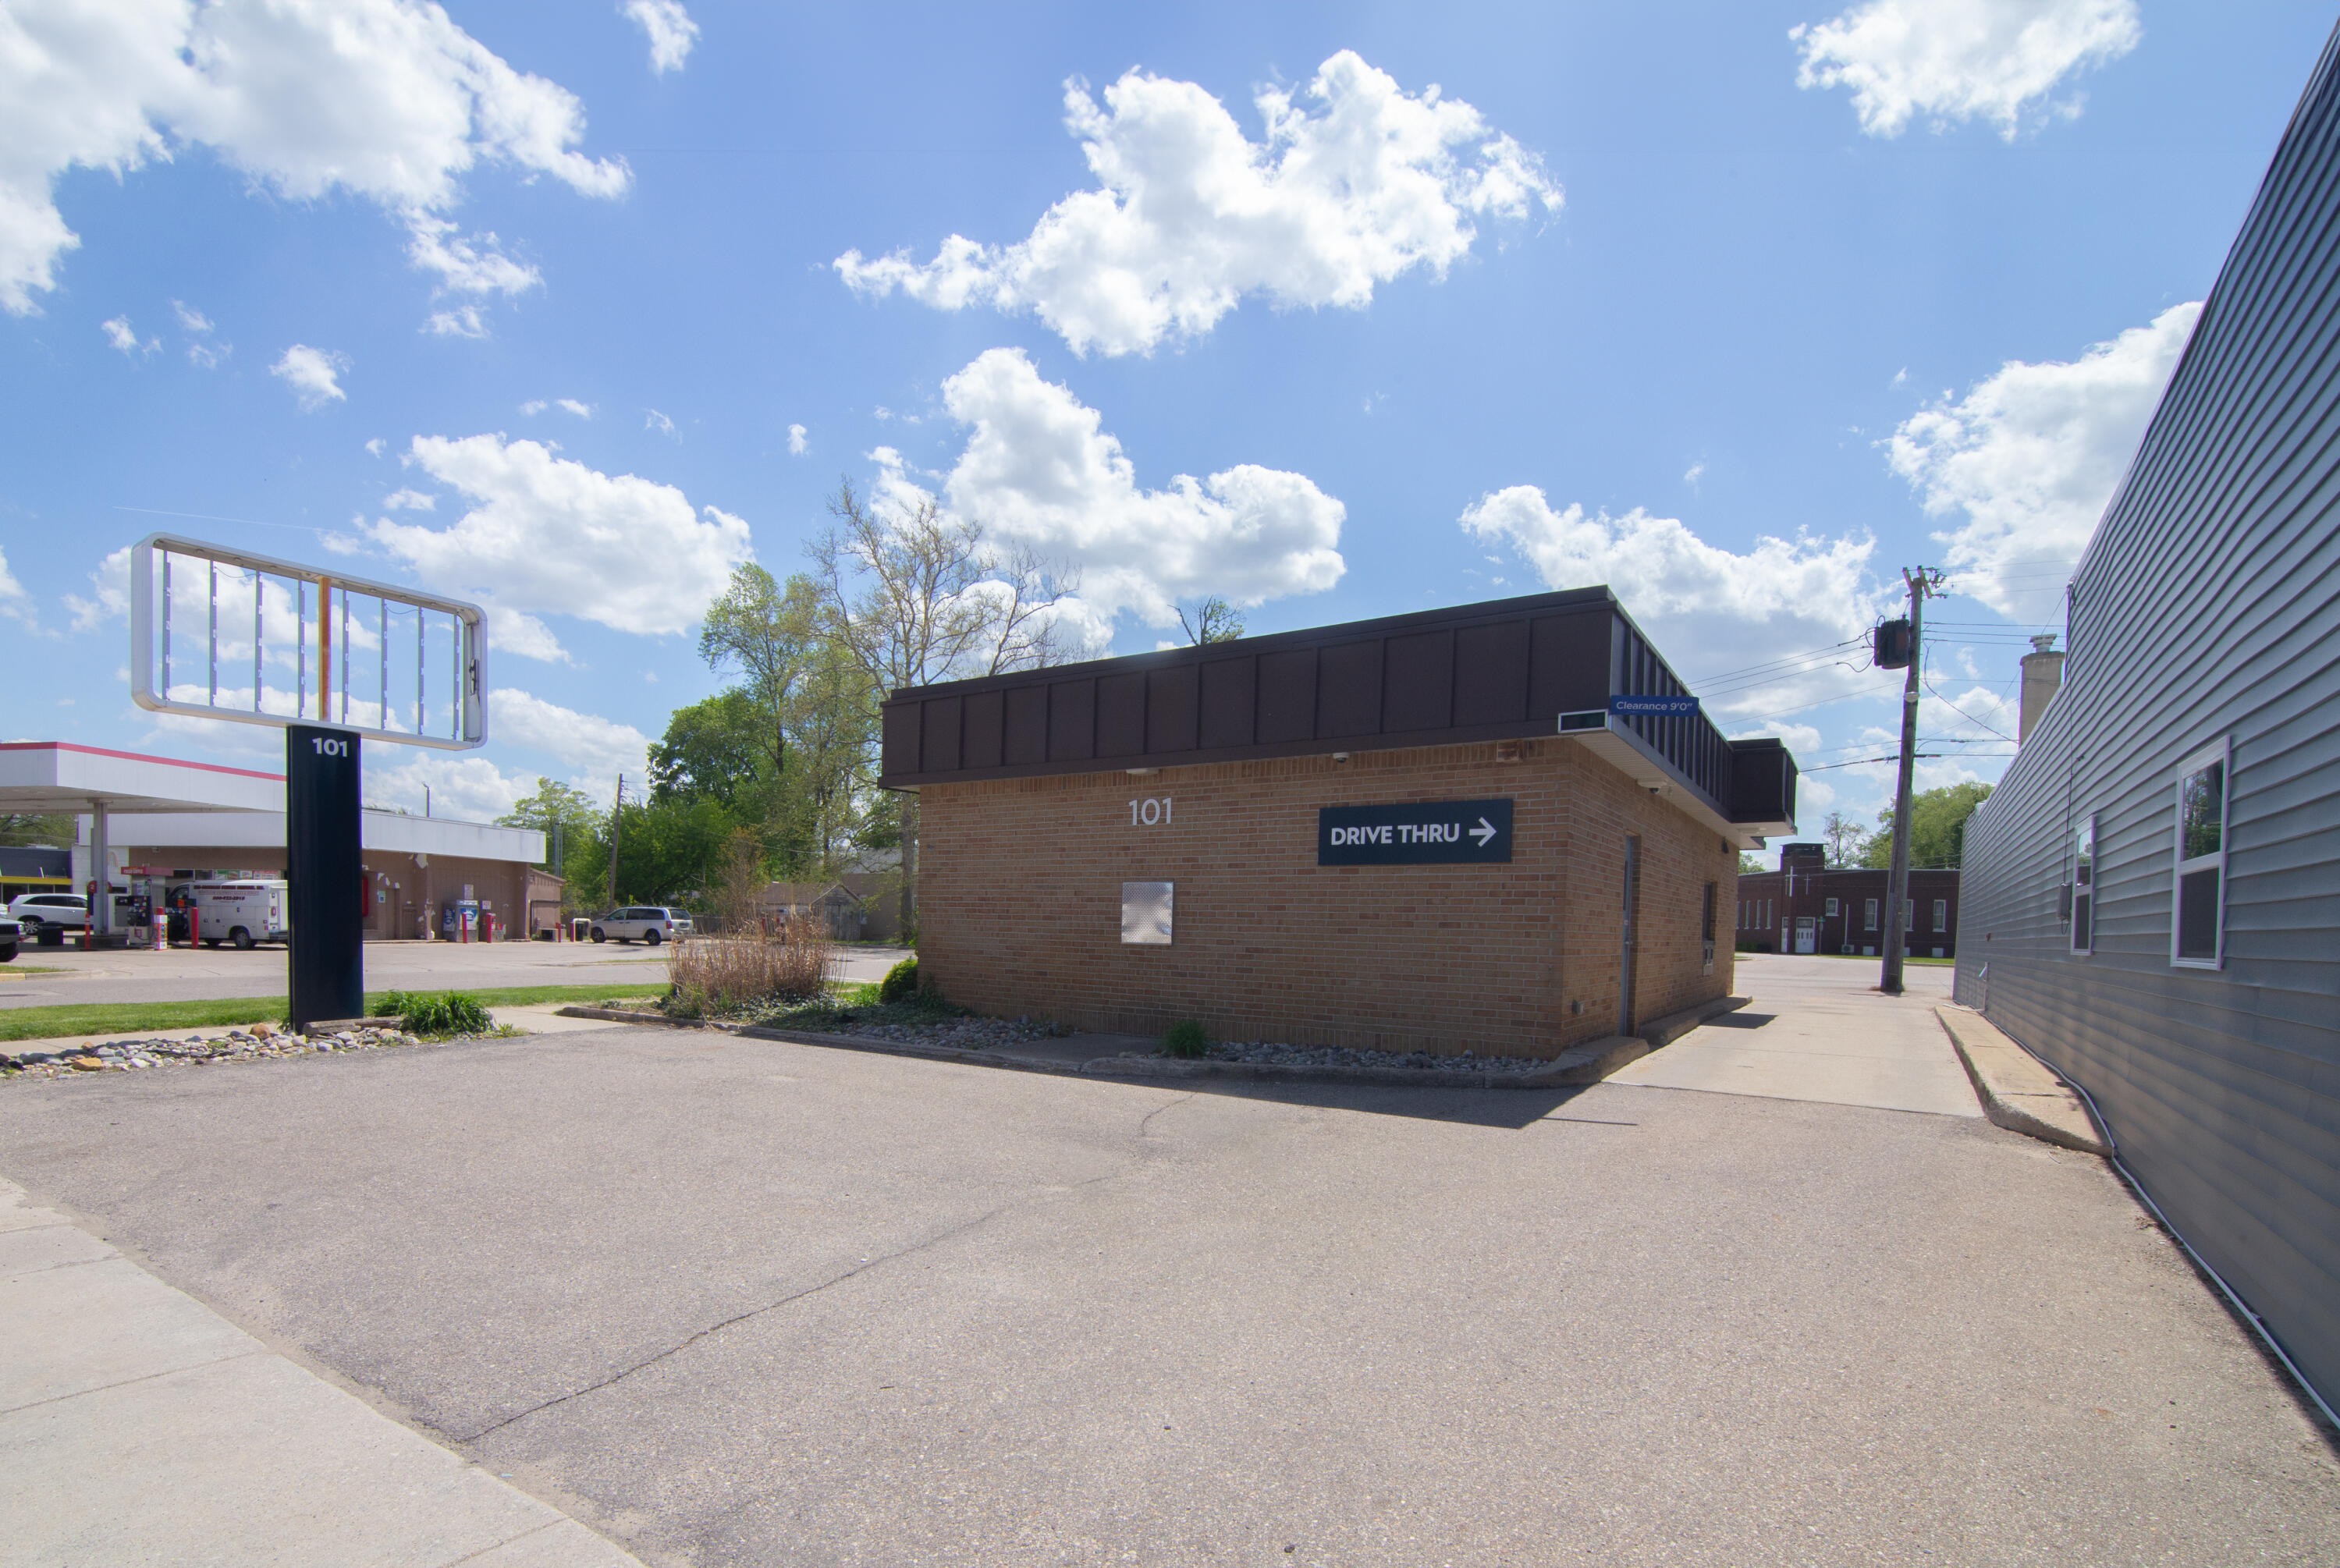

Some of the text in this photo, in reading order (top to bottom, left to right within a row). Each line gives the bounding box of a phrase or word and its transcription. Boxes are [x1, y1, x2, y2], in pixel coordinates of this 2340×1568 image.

[1616, 701, 1667, 711] Clearance
[312, 737, 348, 757] 101
[1128, 797, 1172, 825] 101
[1331, 823, 1460, 846] DRIVE THRU
